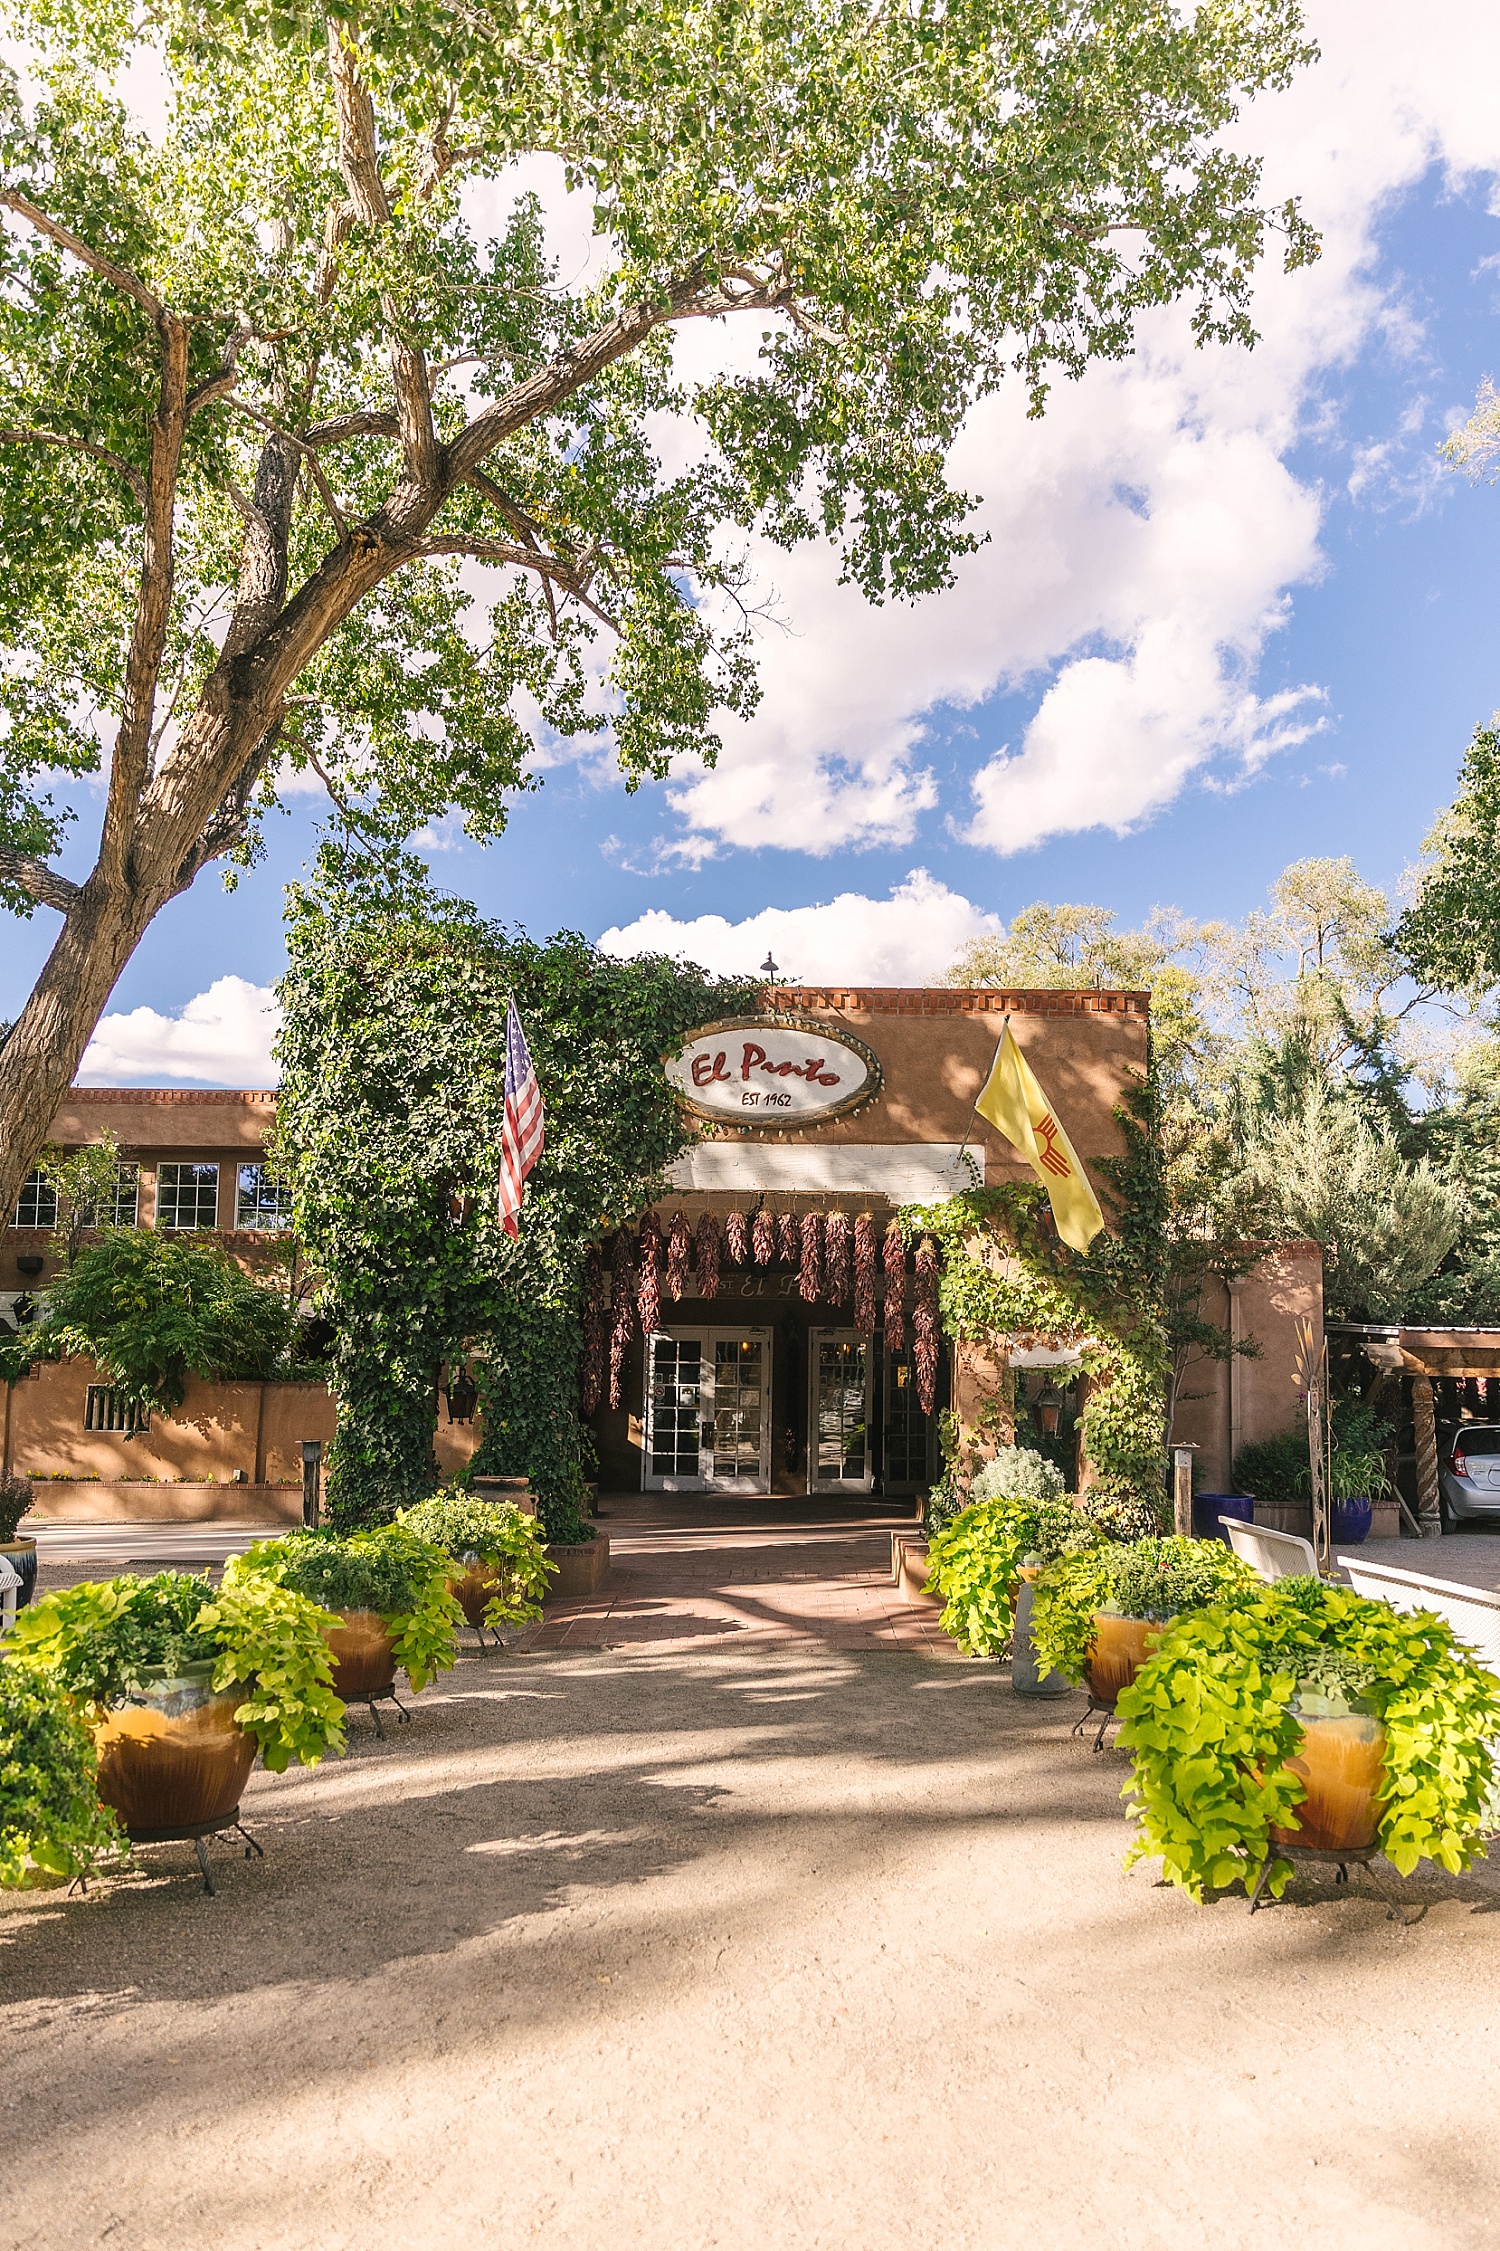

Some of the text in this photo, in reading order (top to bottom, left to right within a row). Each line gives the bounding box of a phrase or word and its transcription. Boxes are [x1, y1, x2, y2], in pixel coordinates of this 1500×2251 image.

[691, 1042, 841, 1087] El Pinto
[741, 1092, 792, 1107] EST 1962
[717, 1280, 734, 1289] ST.
